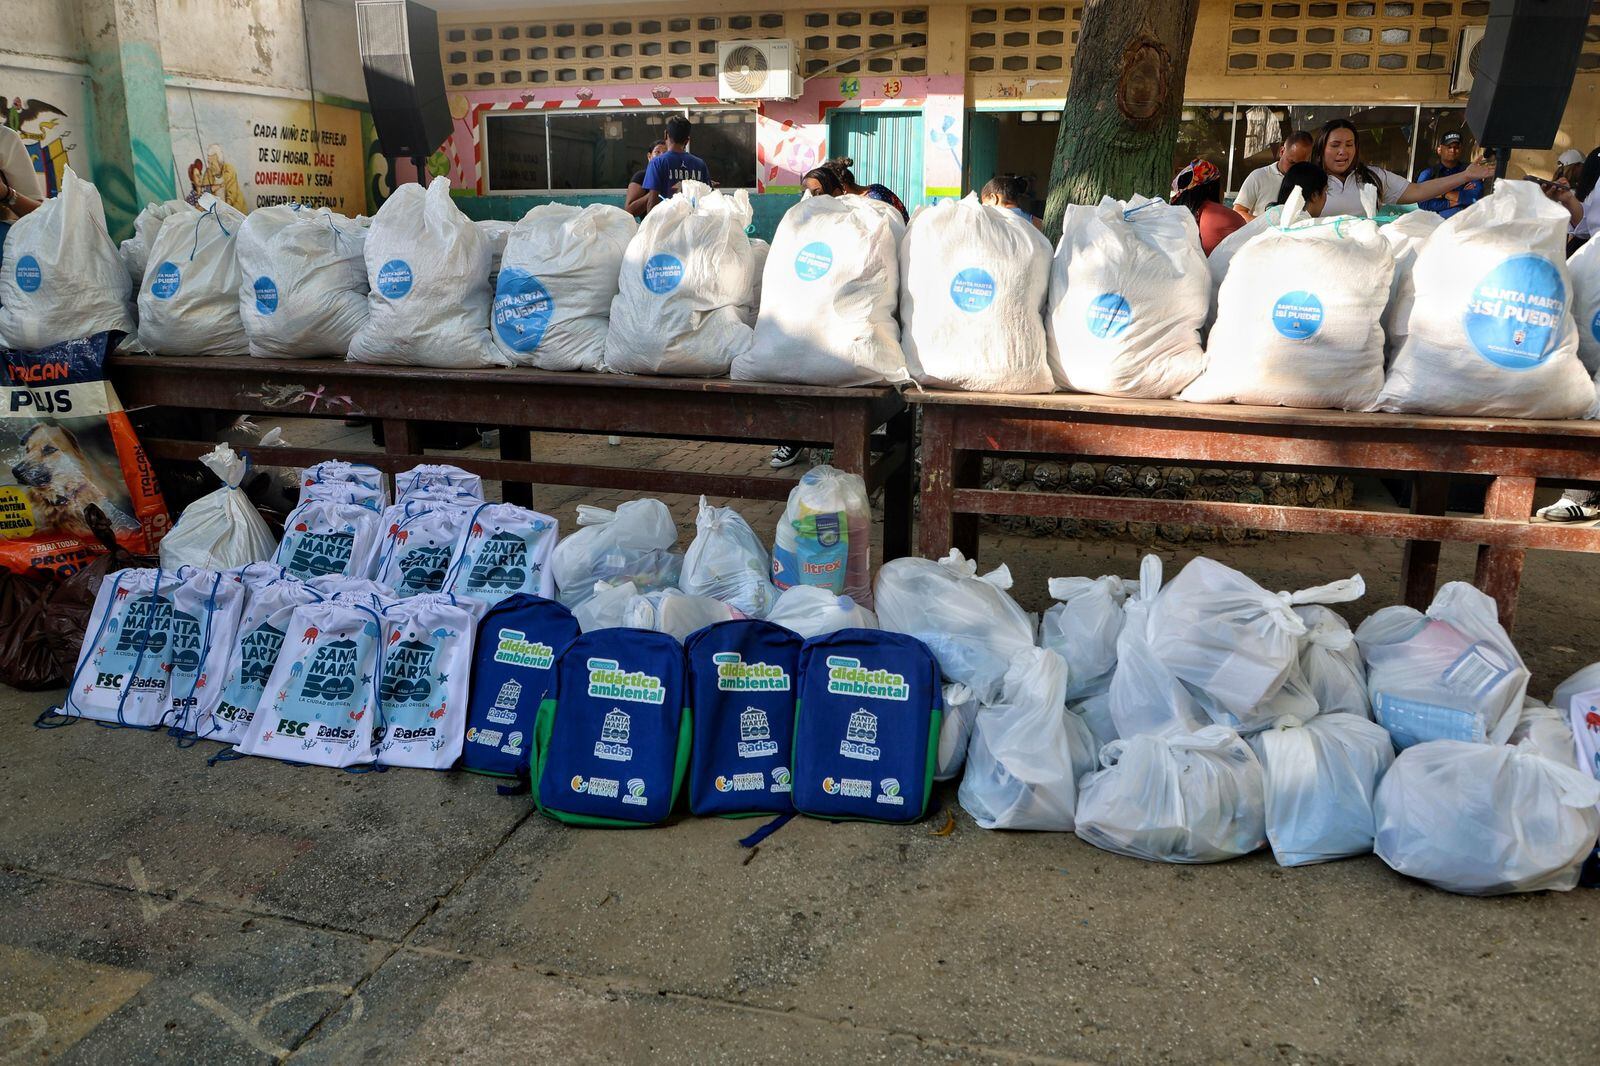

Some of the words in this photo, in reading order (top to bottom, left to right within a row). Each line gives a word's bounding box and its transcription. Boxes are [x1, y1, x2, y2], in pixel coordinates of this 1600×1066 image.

[840, 81, 859, 92] 1-1
[883, 81, 900, 93] 1-3
[254, 124, 277, 138] CADA
[280, 124, 298, 141] NIÑO
[300, 129, 309, 142] ES
[310, 130, 320, 143] UN
[321, 131, 347, 146] REFLEJO
[259, 148, 268, 161] DE
[270, 148, 281, 163] SU
[314, 152, 335, 167] DALE
[255, 172, 304, 186] CONFIANZA
[307, 173, 312, 186] Y
[315, 170, 333, 186] SERÁ
[669, 169, 702, 180] JORDAN
[340, 197, 345, 208] Y
[514, 291, 544, 304] MARTA
[965, 287, 992, 296] PUEDE!
[1480, 287, 1525, 303] SANTA
[505, 301, 548, 321] PUEDE!
[1288, 312, 1320, 321] PUEDE!
[1298, 305, 1321, 313] MARTA
[1503, 305, 1559, 328] PUEDE
[36, 542, 57, 553] PARA
[57, 539, 79, 549] TODAS
[297, 537, 352, 560] MARTA
[482, 541, 527, 554] SANTA
[475, 553, 527, 567] MARTA
[467, 565, 526, 590] 500
[123, 615, 170, 630] MATA
[500, 639, 552, 657] didáctica
[495, 651, 552, 668] ambiental
[720, 664, 782, 678] didáctica
[832, 668, 902, 685] didáctica
[96, 672, 124, 687] FSC
[300, 673, 354, 701] 500
[591, 670, 658, 689] didáctica
[720, 676, 788, 689] ambiental
[590, 684, 663, 702] ambiental
[830, 681, 907, 698] ambiental
[605, 721, 628, 730] MARTA
[606, 715, 628, 723] SANTA
[850, 721, 875, 730] MARTA
[851, 715, 875, 724] SANTA
[276, 718, 310, 736] FSC
